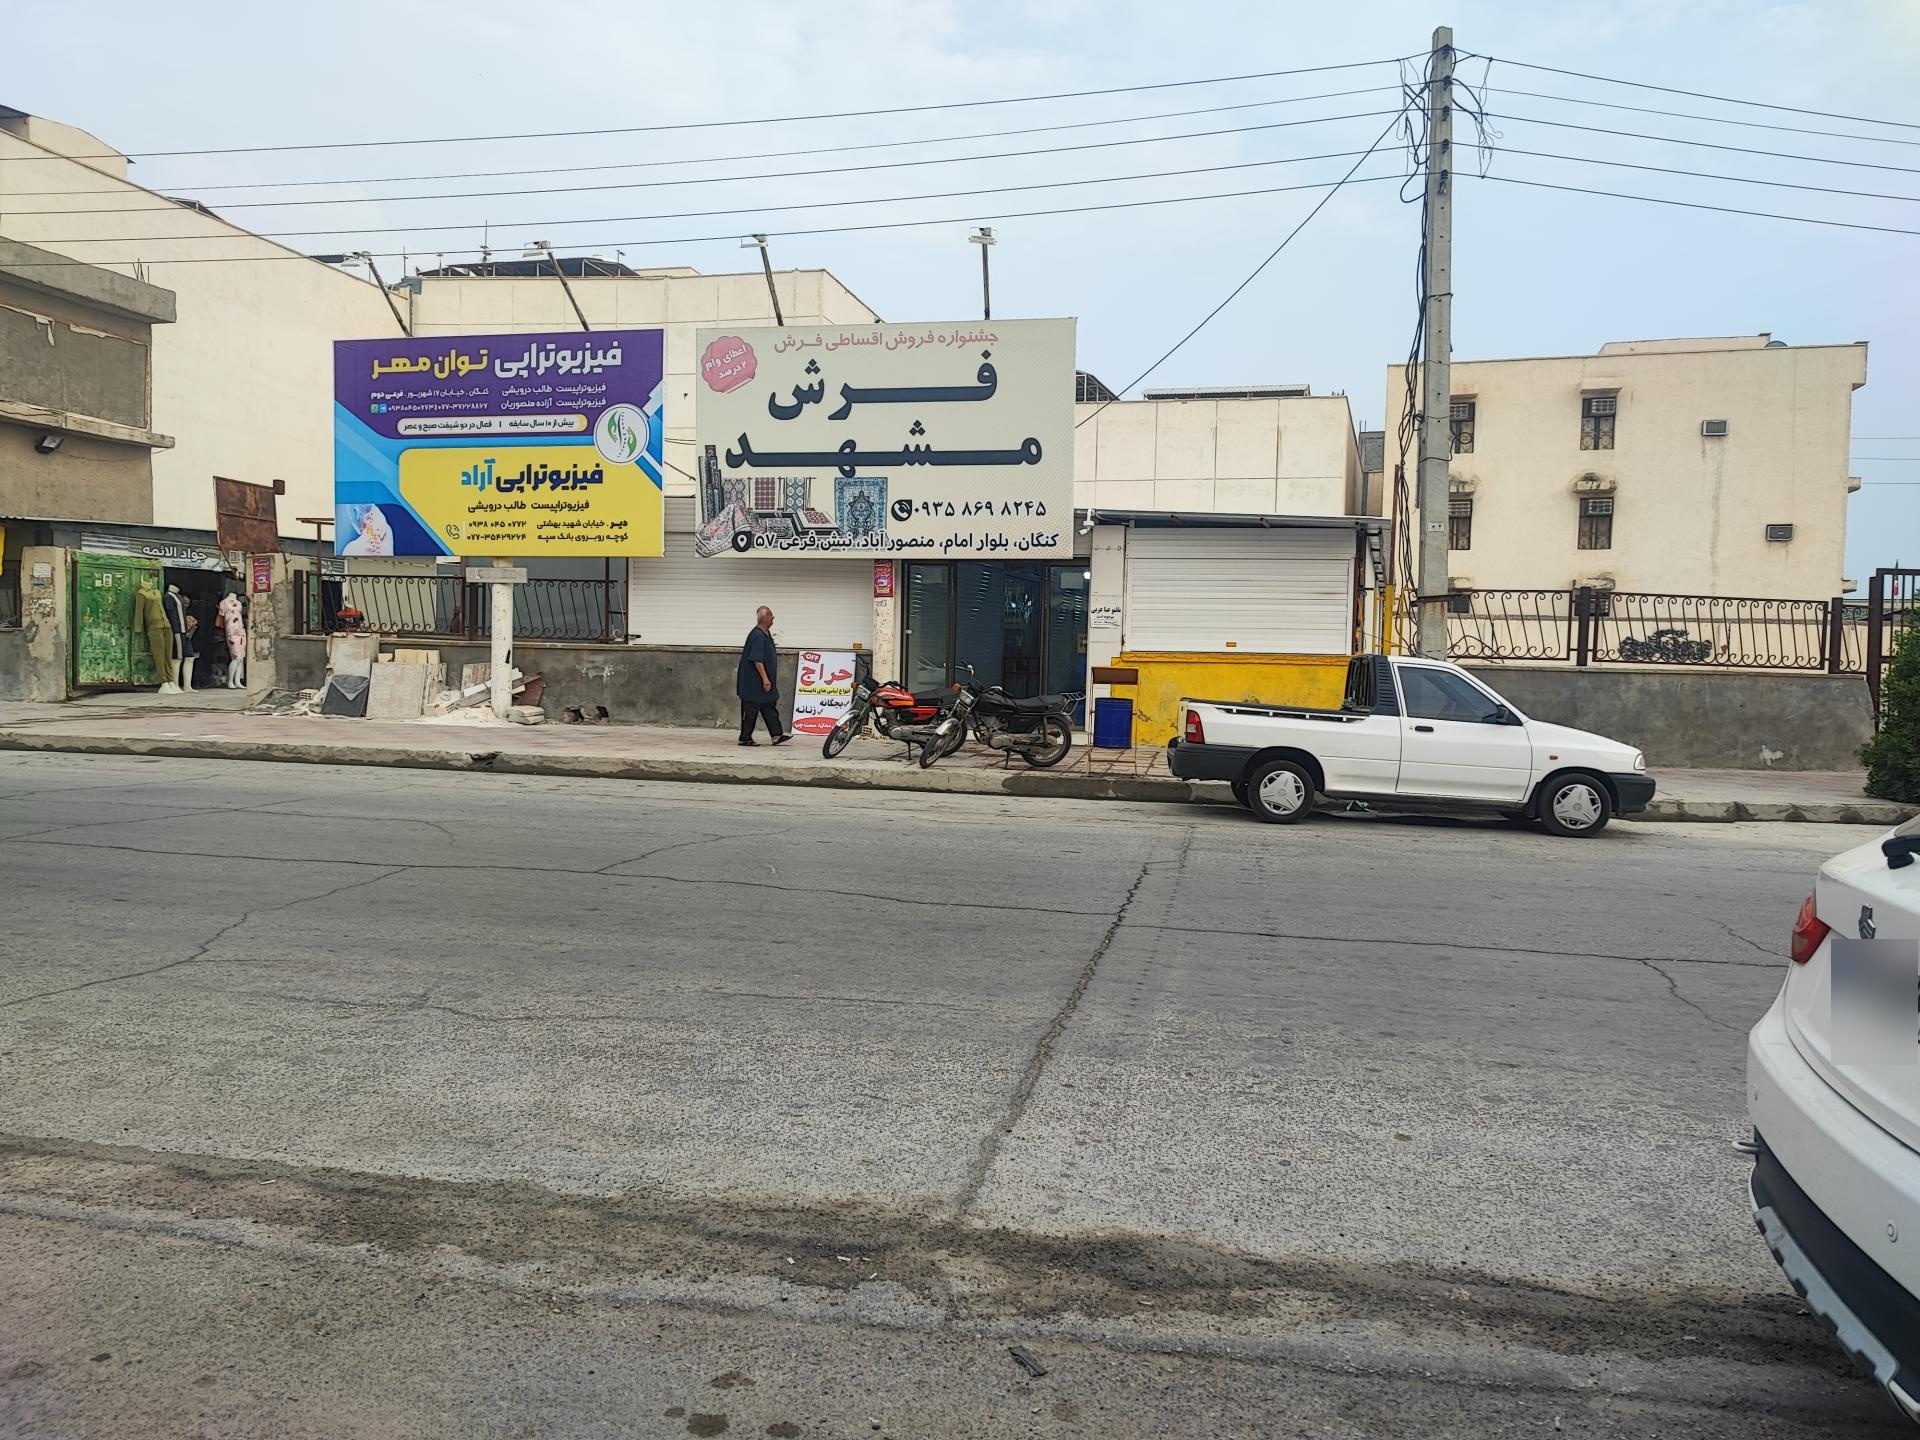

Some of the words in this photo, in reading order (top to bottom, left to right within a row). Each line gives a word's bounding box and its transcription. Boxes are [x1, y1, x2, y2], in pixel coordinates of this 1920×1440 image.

[774, 333, 823, 353] فرش
[825, 332, 882, 351] اقساطی
[885, 331, 934, 350] فروش
[938, 329, 999, 349] جشنواره
[494, 341, 622, 378] فیزیوتراپی
[723, 344, 747, 364] اعطای
[371, 356, 431, 380] مهر
[433, 349, 489, 379] توان
[705, 358, 722, 371] وام
[532, 384, 552, 395] طالب
[556, 382, 606, 395] فیزیوتراپیست
[768, 349, 998, 420] فرش
[371, 391, 385, 400] دوم
[385, 389, 404, 400] فرعی
[407, 388, 432, 399] شهریور
[440, 388, 465, 398] خیابان
[468, 387, 489, 397] کنگان
[501, 385, 531, 396] درویشی
[500, 399, 535, 410] منصوریان
[536, 398, 552, 409] آزاده
[556, 397, 606, 410] فیزیوتراپیست
[403, 424, 417, 432] عصر
[422, 423, 437, 432] صبح
[437, 421, 459, 430] شیفت
[460, 422, 468, 430] دو
[469, 422, 476, 430] در
[476, 420, 492, 430] فعال
[508, 420, 529, 429] سابقه
[529, 419, 545, 428] سال
[552, 419, 558, 428] از
[557, 418, 575, 428] بیش
[725, 419, 1043, 478] مشهد
[461, 458, 496, 492] آراد
[496, 463, 603, 493] فیزیوتراپی
[468, 501, 502, 513] درویشی
[504, 500, 527, 513] طالب
[531, 500, 590, 514] فیزیوتراپیست
[961, 500, 994, 517] ۸۶۹
[1000, 500, 1047, 517] ۸۲۴۵
[536, 520, 561, 529] بهشتی
[562, 519, 581, 528] شهید
[582, 520, 605, 528] خیابان
[610, 520, 628, 529] دیر
[537, 533, 556, 543] سپه
[557, 532, 574, 542] بانک
[606, 532, 629, 543] کوچه
[755, 534, 775, 547] ۵۷
[779, 531, 816, 551] فرعی
[819, 532, 852, 551] نبش
[976, 532, 1009, 551] بلوار
[180, 548, 207, 562] جواد
[805, 652, 819, 661] OFF
[800, 664, 853, 687] حراج
[819, 698, 844, 710] بچگانه
[795, 705, 816, 716] زنانه
